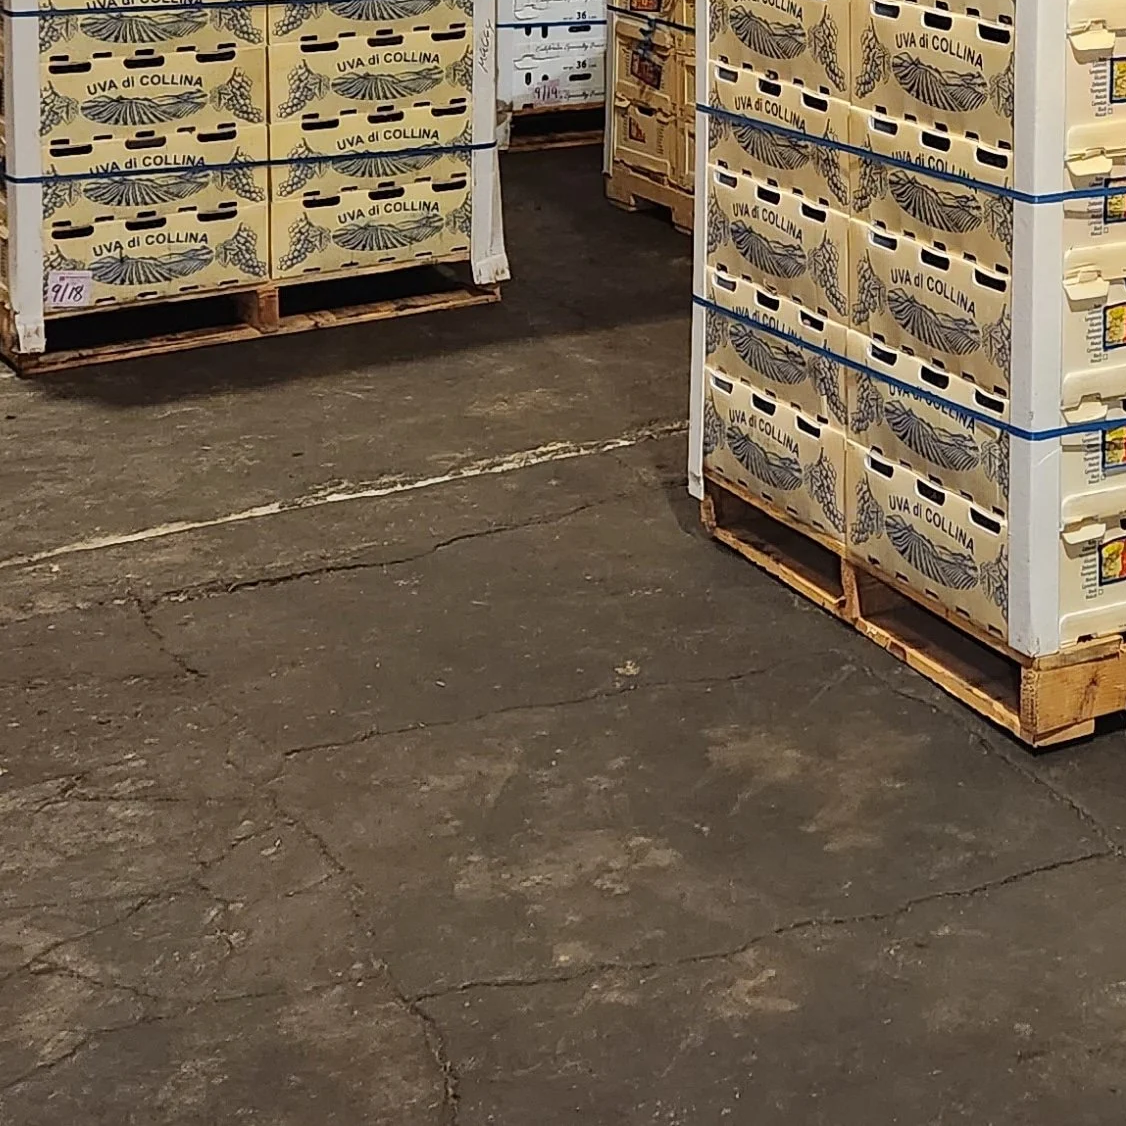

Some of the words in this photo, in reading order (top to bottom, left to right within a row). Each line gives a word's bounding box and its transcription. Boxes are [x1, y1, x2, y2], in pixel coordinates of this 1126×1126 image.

[896, 34, 916, 49] UVA
[919, 32, 930, 49] di
[932, 34, 983, 70] COLLINA
[86, 80, 120, 96] UVA
[122, 75, 134, 88] di
[137, 74, 203, 89] COLLINA
[336, 136, 365, 151] UVA
[368, 132, 380, 145] di
[384, 129, 439, 144] COLLINA
[338, 209, 366, 224] UVA
[368, 204, 380, 216] di
[384, 201, 440, 216] COLLINA
[732, 203, 750, 219] UVA
[752, 204, 761, 220] di
[762, 208, 803, 241] COLLINA
[92, 242, 124, 258] UVA
[127, 236, 140, 250] di
[144, 232, 208, 246] COLLINA
[49, 283, 84, 302] 9/18
[890, 268, 912, 285] UVA
[914, 272, 924, 288] di
[926, 274, 976, 318] COLLINA
[728, 409, 746, 424] UVA
[748, 412, 758, 428] di
[758, 417, 800, 456] COLLINA
